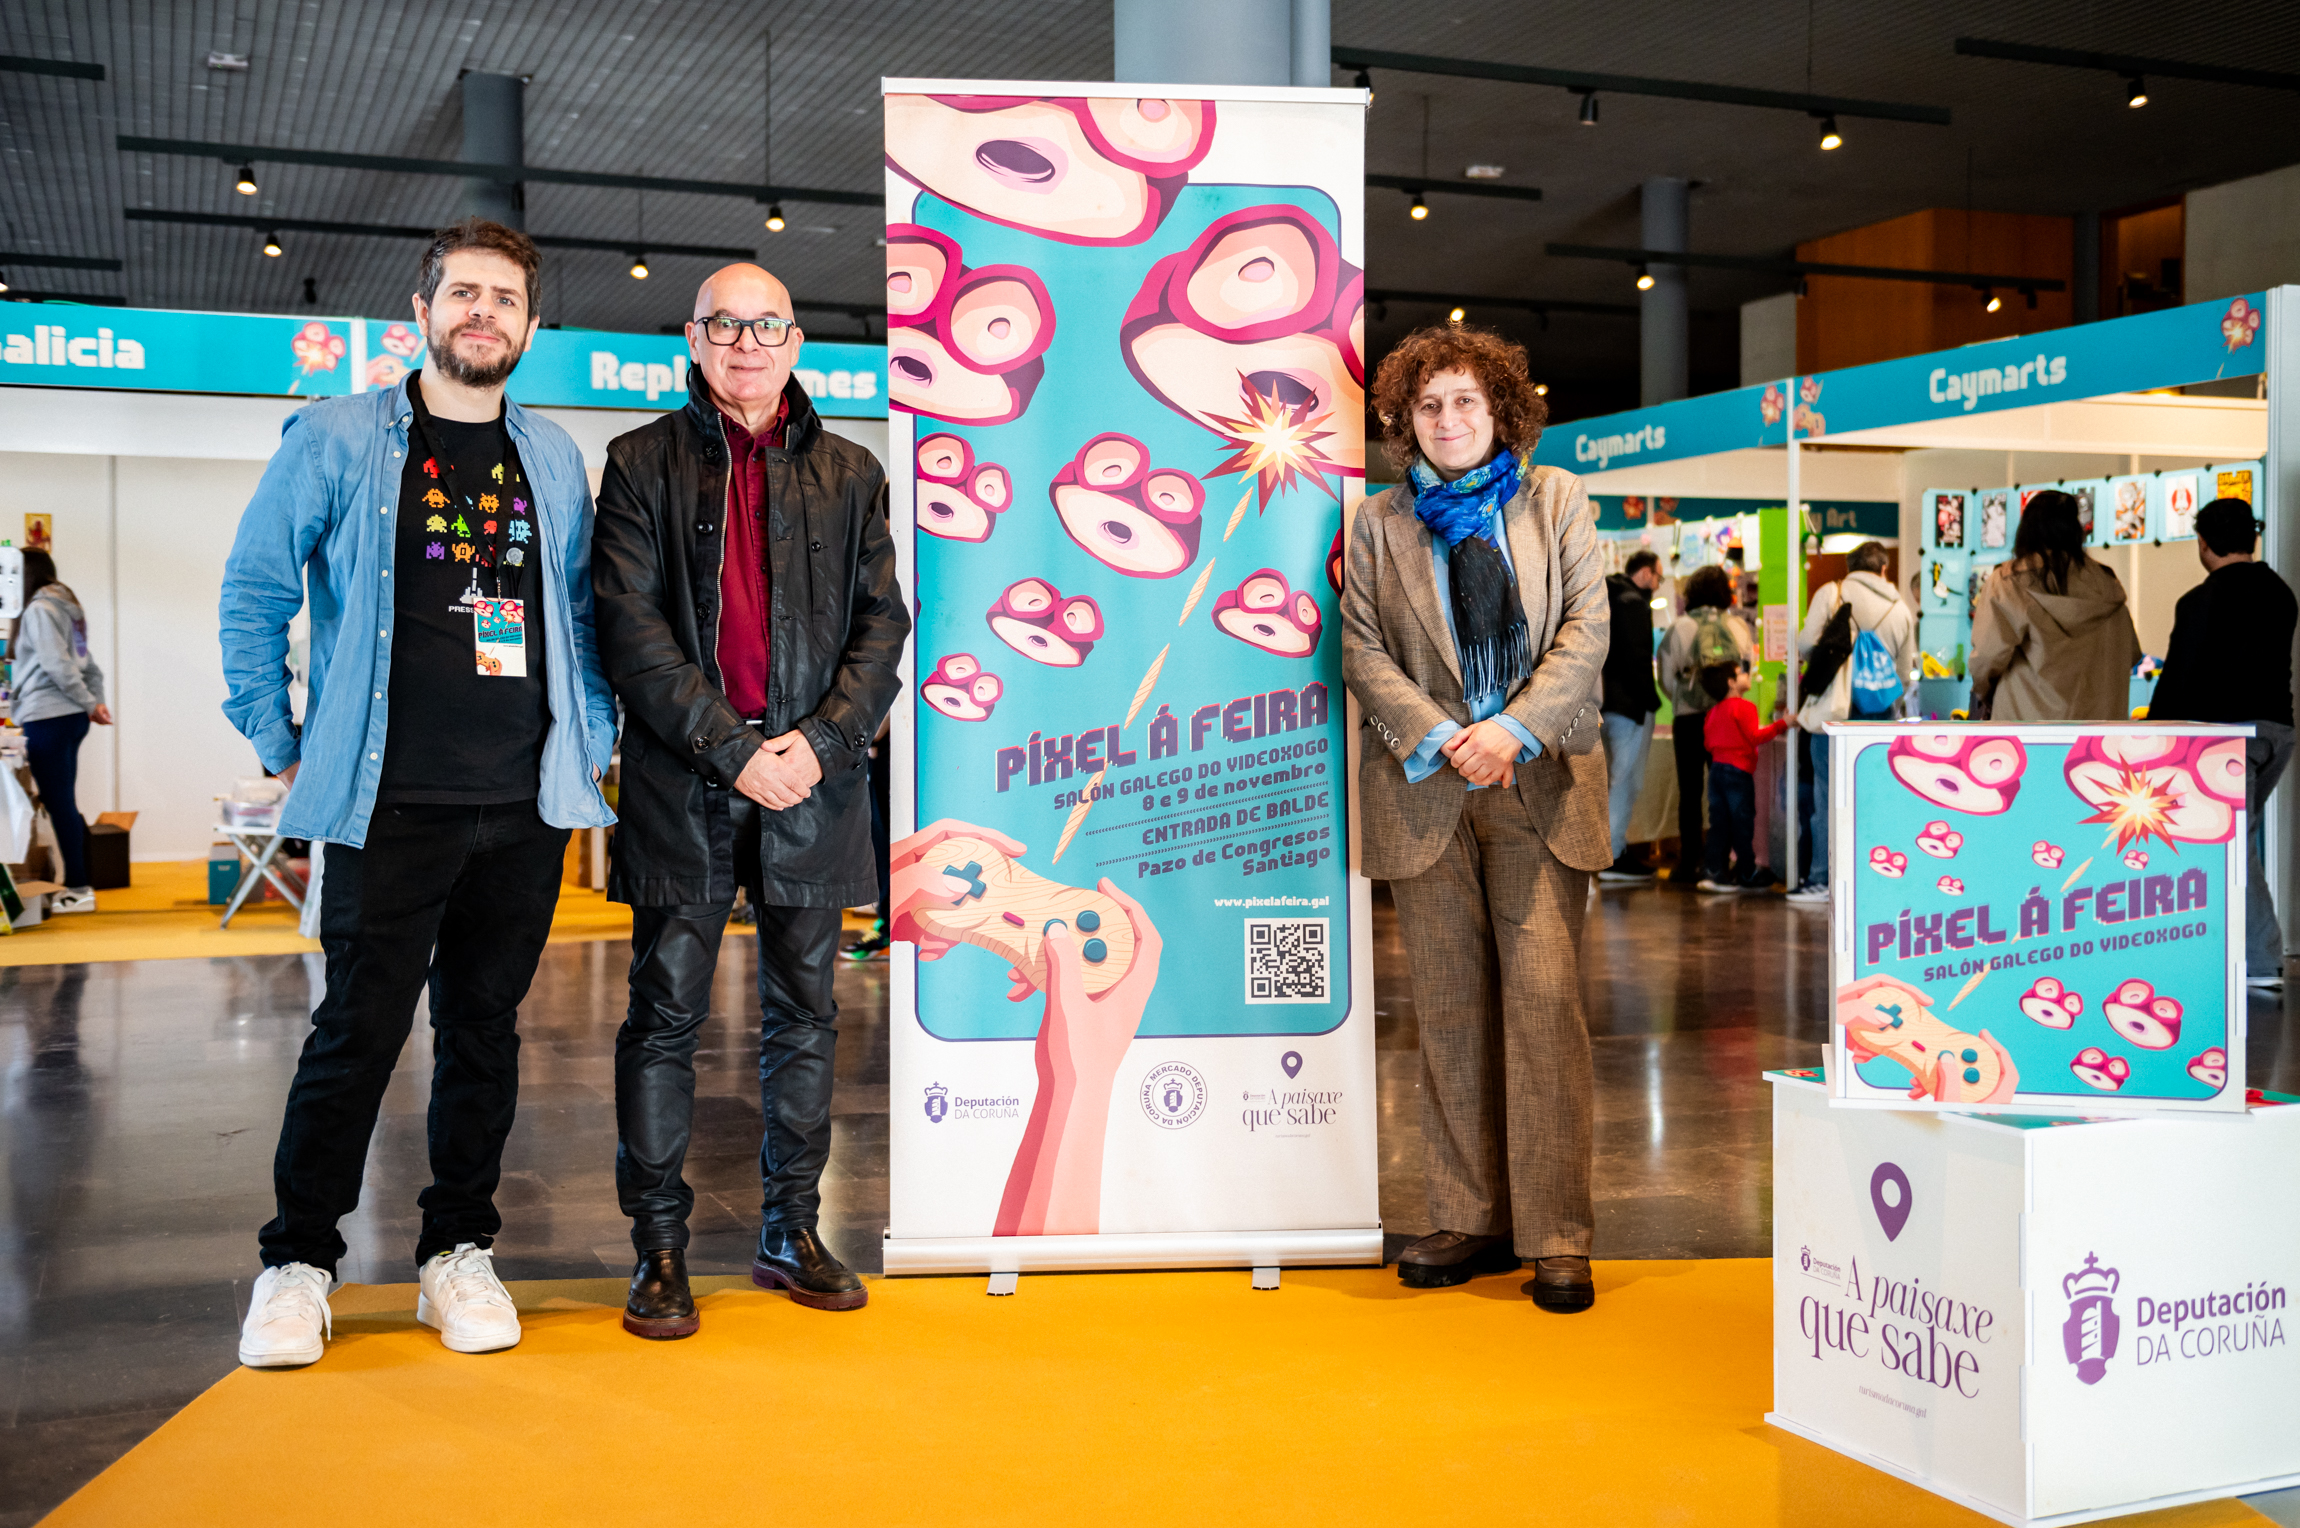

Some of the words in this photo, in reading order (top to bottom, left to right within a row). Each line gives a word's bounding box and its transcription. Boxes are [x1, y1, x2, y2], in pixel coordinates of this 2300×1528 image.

[0, 324, 146, 370] alicia
[590, 350, 688, 401] Repl
[791, 369, 877, 400] mes
[1929, 354, 2067, 410] Caymarts
[1575, 424, 1665, 469] Caymarts
[995, 724, 1137, 793] PÍXEL
[1148, 704, 1178, 761] Á
[1189, 681, 1328, 752] FEIRA
[1053, 782, 1115, 810] SALÓN
[1120, 766, 1193, 796] GALEGO
[1198, 760, 1222, 780] DO
[1227, 737, 1328, 772] VIDEOXOGO
[1142, 795, 1155, 811] 8
[1160, 796, 1171, 808] e
[1177, 787, 1189, 804] 9
[1194, 781, 1218, 800] de
[1224, 763, 1326, 795] novembro
[1142, 812, 1231, 845] ENTRADA
[1237, 806, 1261, 826] DE
[1266, 791, 1329, 820] BALDE
[1138, 857, 1186, 879] Pazo
[1192, 849, 1216, 866] de
[1221, 826, 1330, 860] Congresos
[1243, 847, 1331, 876] Santiago
[1214, 895, 1330, 909] www.pixelafeira.gal
[1865, 903, 2007, 966] PÍXEL
[2019, 885, 2050, 939] Á
[2060, 866, 2207, 933] FEIRA
[1923, 956, 1985, 982] SALÓN
[1990, 945, 2064, 971] GALEGO
[2069, 940, 2094, 958] DO
[2100, 921, 2207, 953] VIDEOXOGO
[1149, 1065, 1192, 1082] MERCADO
[1268, 1088, 1278, 1105] A
[1281, 1089, 1343, 1109] paisaxe
[955, 1096, 1019, 1109] Deputación
[955, 1109, 970, 1119] DA
[973, 1107, 1019, 1119] CORUÑA
[1162, 1117, 1173, 1126] DA
[1242, 1108, 1281, 1132] que
[1286, 1103, 1337, 1125] sabe
[1844, 1255, 1864, 1302] A
[1867, 1276, 1994, 1344] paisaxe
[2137, 1281, 2286, 1332] Deputación
[1799, 1296, 1869, 1361] que
[1881, 1324, 1980, 1399] sabe
[2137, 1334, 2171, 1366] DA
[2181, 1314, 2286, 1359] CORUÑA
